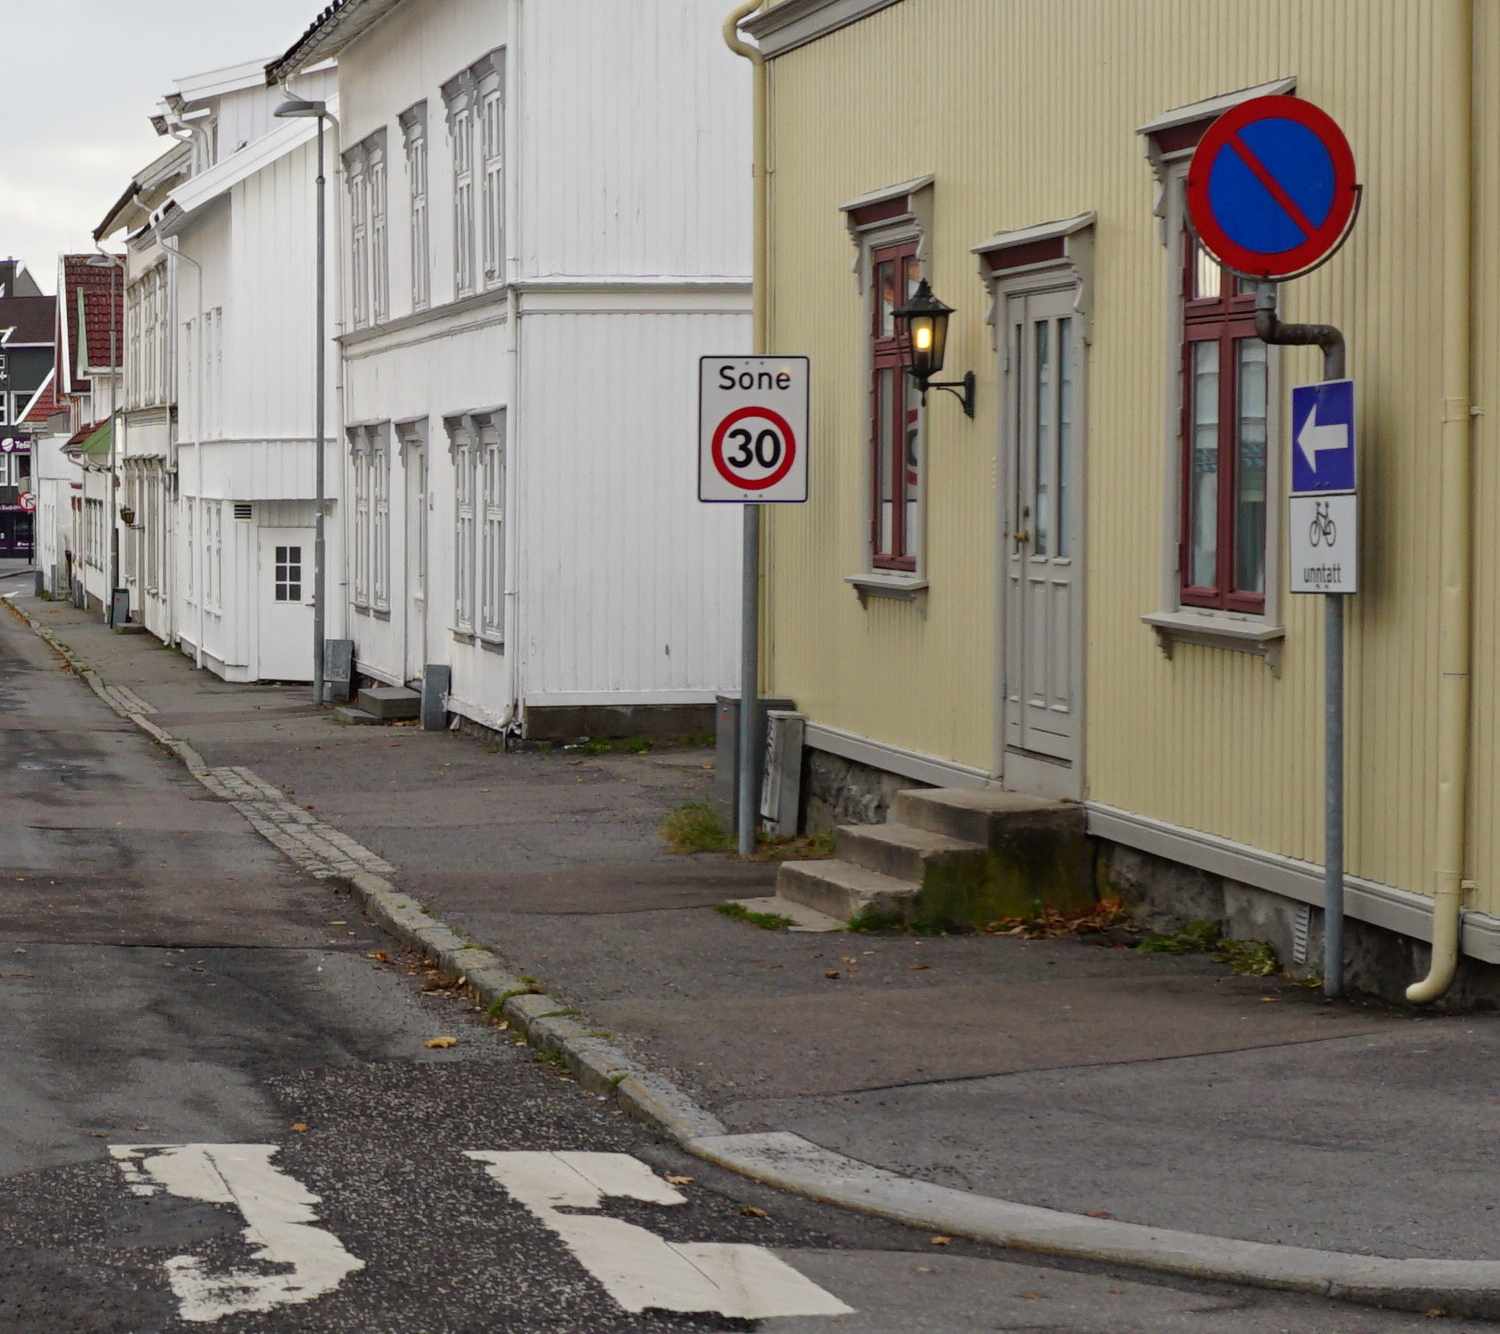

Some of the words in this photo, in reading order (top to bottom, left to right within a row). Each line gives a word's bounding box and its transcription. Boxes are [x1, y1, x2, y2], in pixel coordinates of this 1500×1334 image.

[718, 365, 791, 390] Sone
[727, 428, 781, 469] 30
[1304, 563, 1341, 583] unntatt
